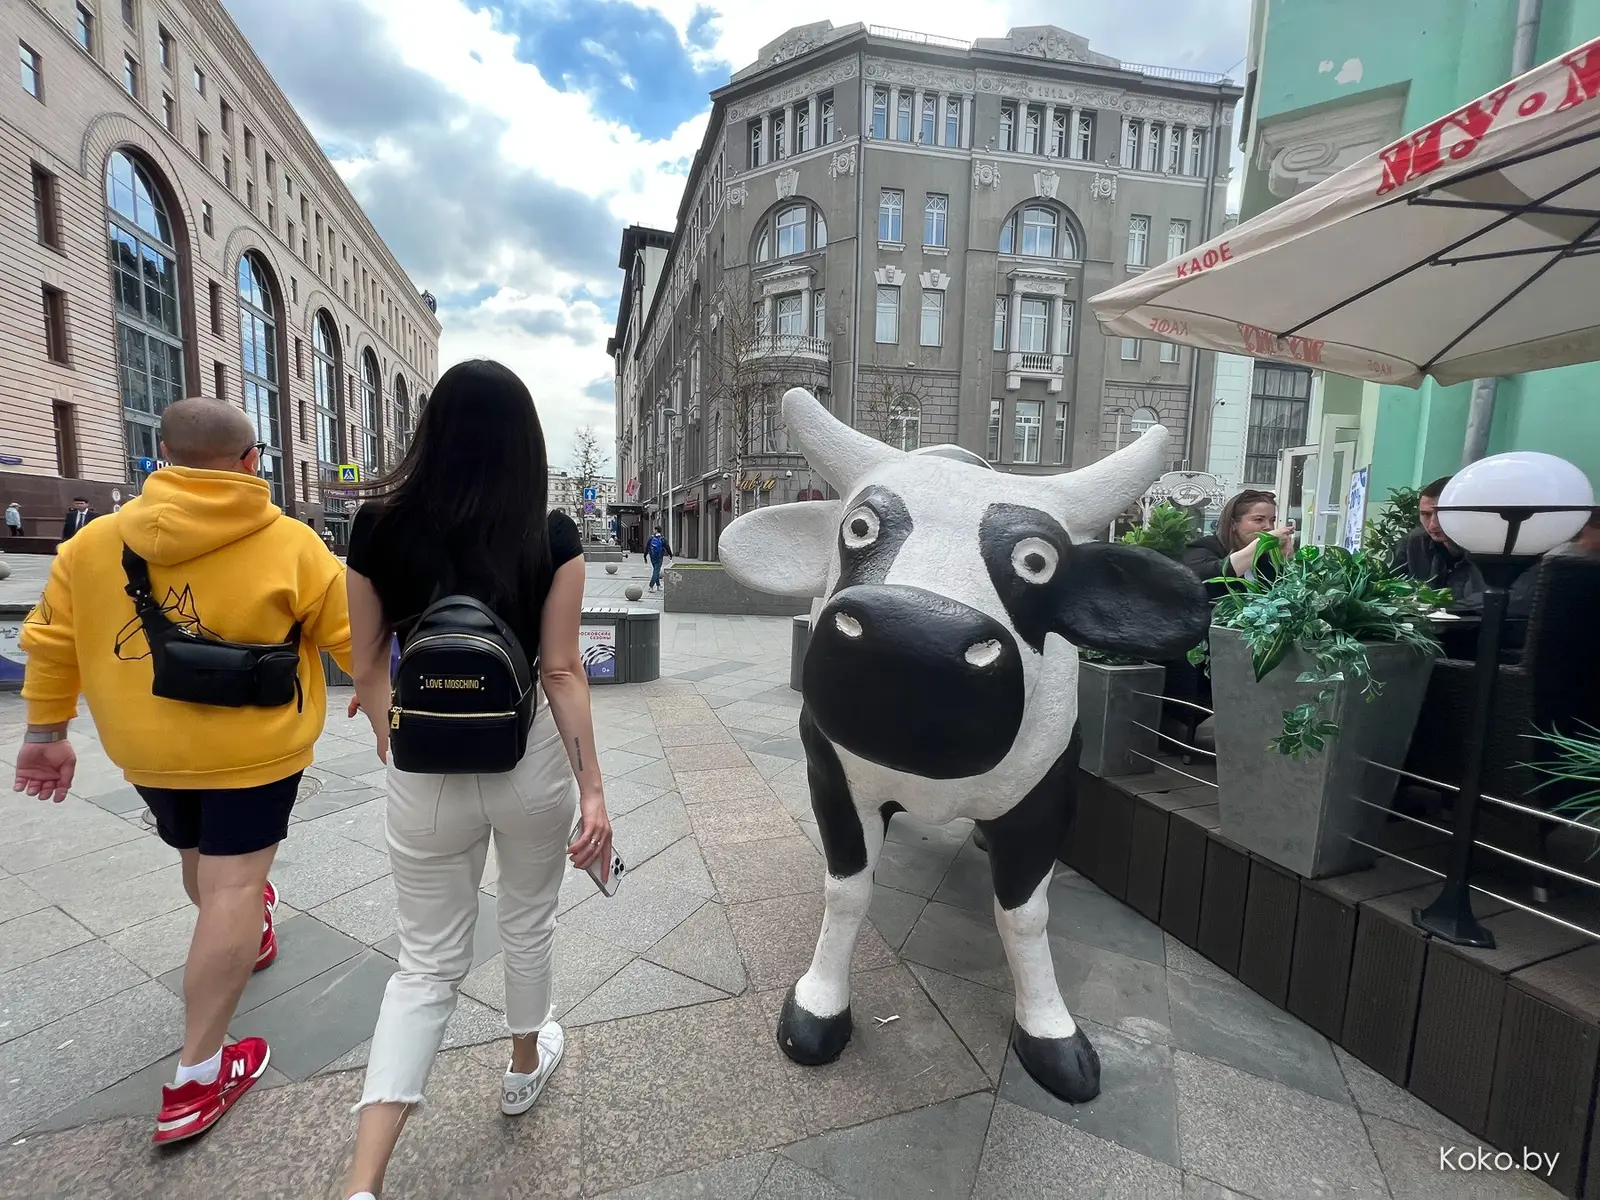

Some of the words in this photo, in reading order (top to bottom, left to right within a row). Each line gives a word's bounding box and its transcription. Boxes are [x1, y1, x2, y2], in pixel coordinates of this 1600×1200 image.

[1177, 241, 1233, 278] КАФЕ
[425, 679, 443, 689] LOVE
[444, 679, 479, 689] MOSCHINO
[231, 1058, 245, 1078] N
